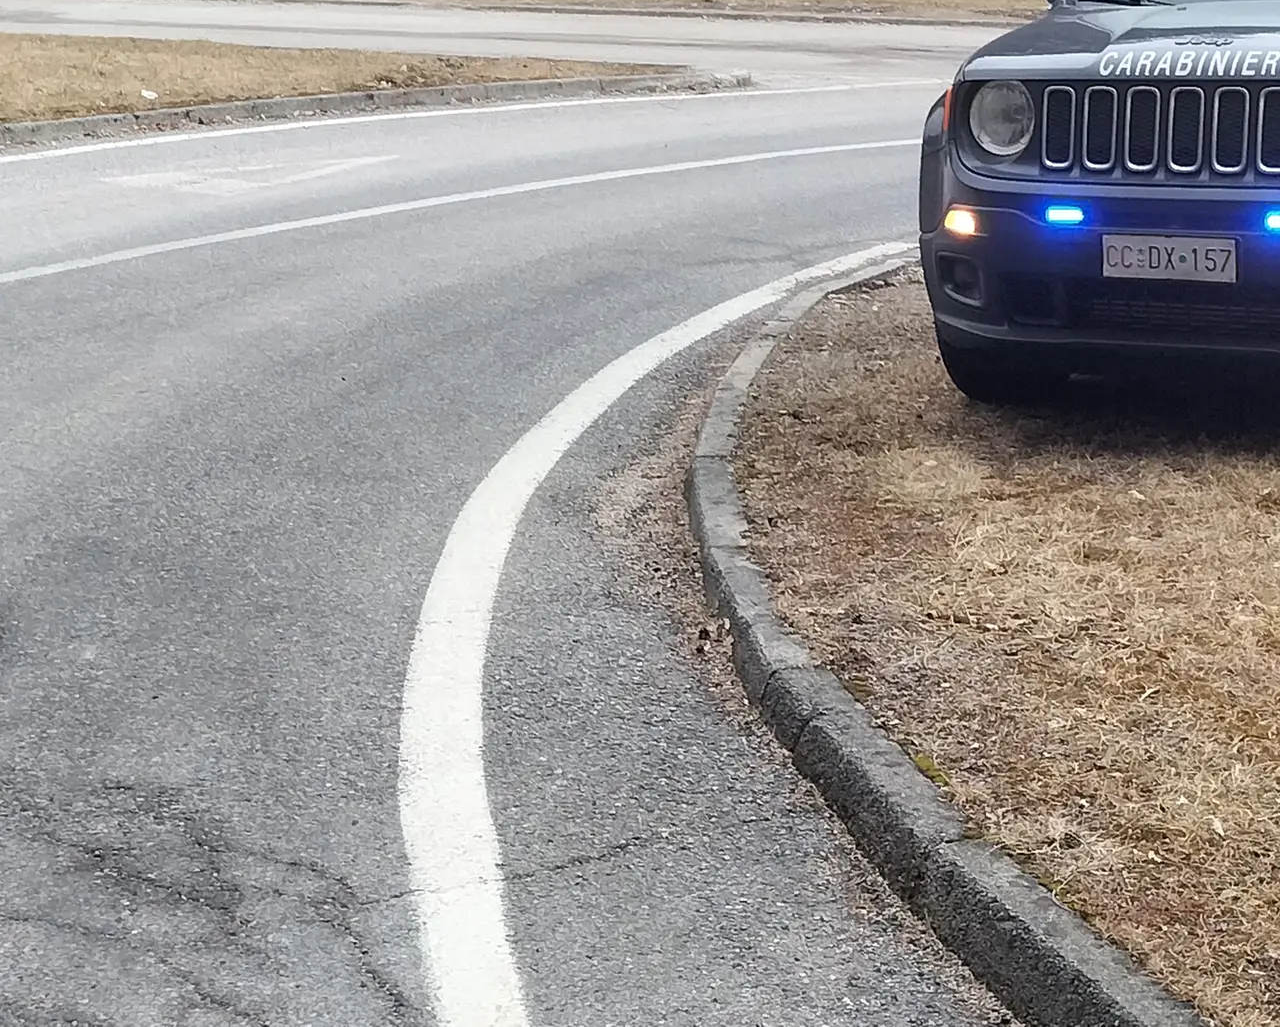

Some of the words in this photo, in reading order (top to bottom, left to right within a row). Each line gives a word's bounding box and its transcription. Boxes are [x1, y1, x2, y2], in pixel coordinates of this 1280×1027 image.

[1106, 244, 1133, 268] CC
[1148, 246, 1176, 271] DX
[1191, 247, 1232, 273] 157
